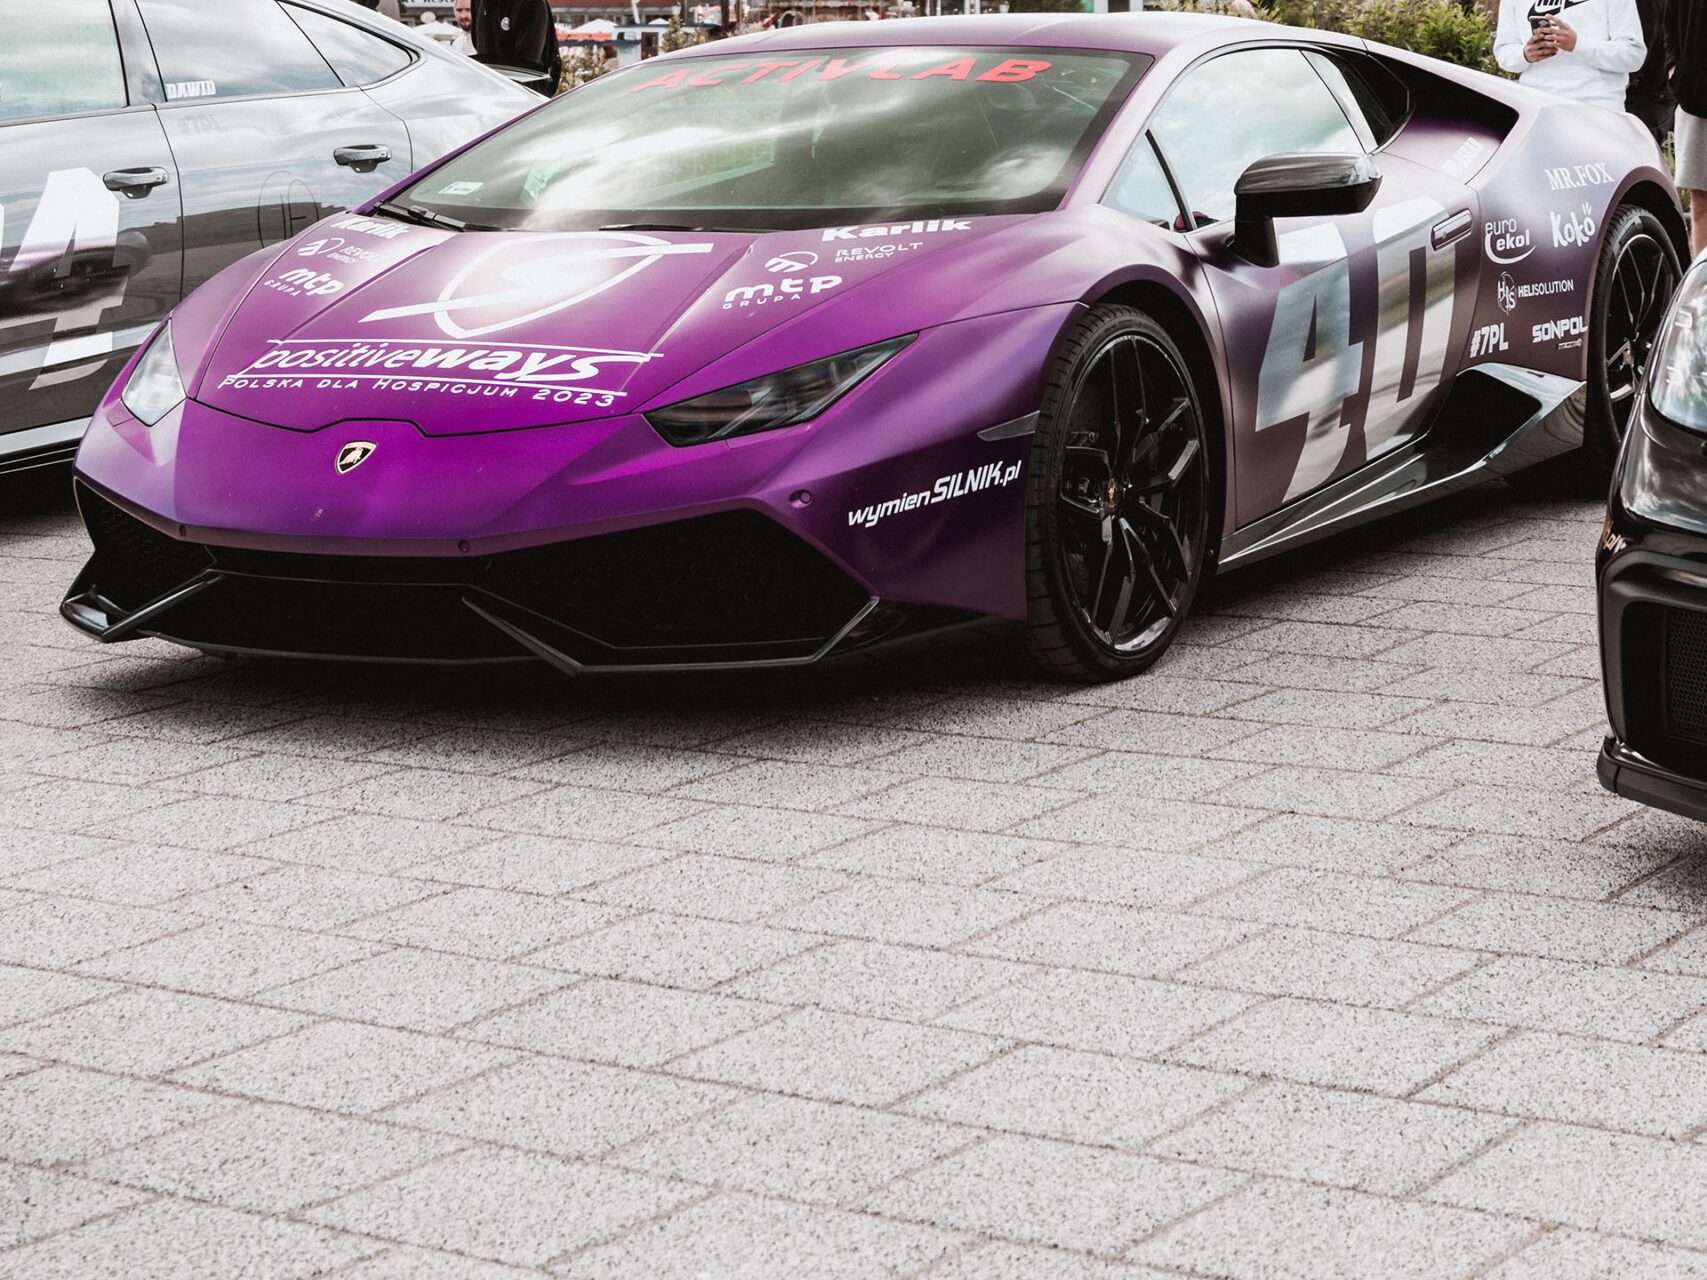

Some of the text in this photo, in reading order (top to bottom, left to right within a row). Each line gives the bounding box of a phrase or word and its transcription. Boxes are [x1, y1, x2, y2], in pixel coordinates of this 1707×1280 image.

[631, 57, 1052, 93] ACTIVLAB
[165, 80, 216, 99] DAWID
[331, 218, 410, 239] Karlik
[821, 220, 972, 242] Karlik
[1484, 218, 1518, 236] euro
[1495, 228, 1531, 252] ekol
[834, 251, 894, 263] ENERGY
[836, 242, 924, 258] REVOLT
[0, 167, 131, 391] 4
[264, 279, 302, 297] GRUPA
[278, 268, 345, 297] mtp
[724, 275, 843, 303] mtp
[1517, 279, 1575, 299] HELISOLUTION
[722, 293, 801, 310] GRUPA
[1469, 322, 1509, 359] #7PL
[1531, 316, 1589, 344] SONPOL
[230, 342, 650, 382] positiveways
[1255, 195, 1457, 504] 40
[316, 379, 358, 389] DLA
[531, 388, 616, 408] 2023
[847, 460, 1023, 529] wymienSILNIK.pl
